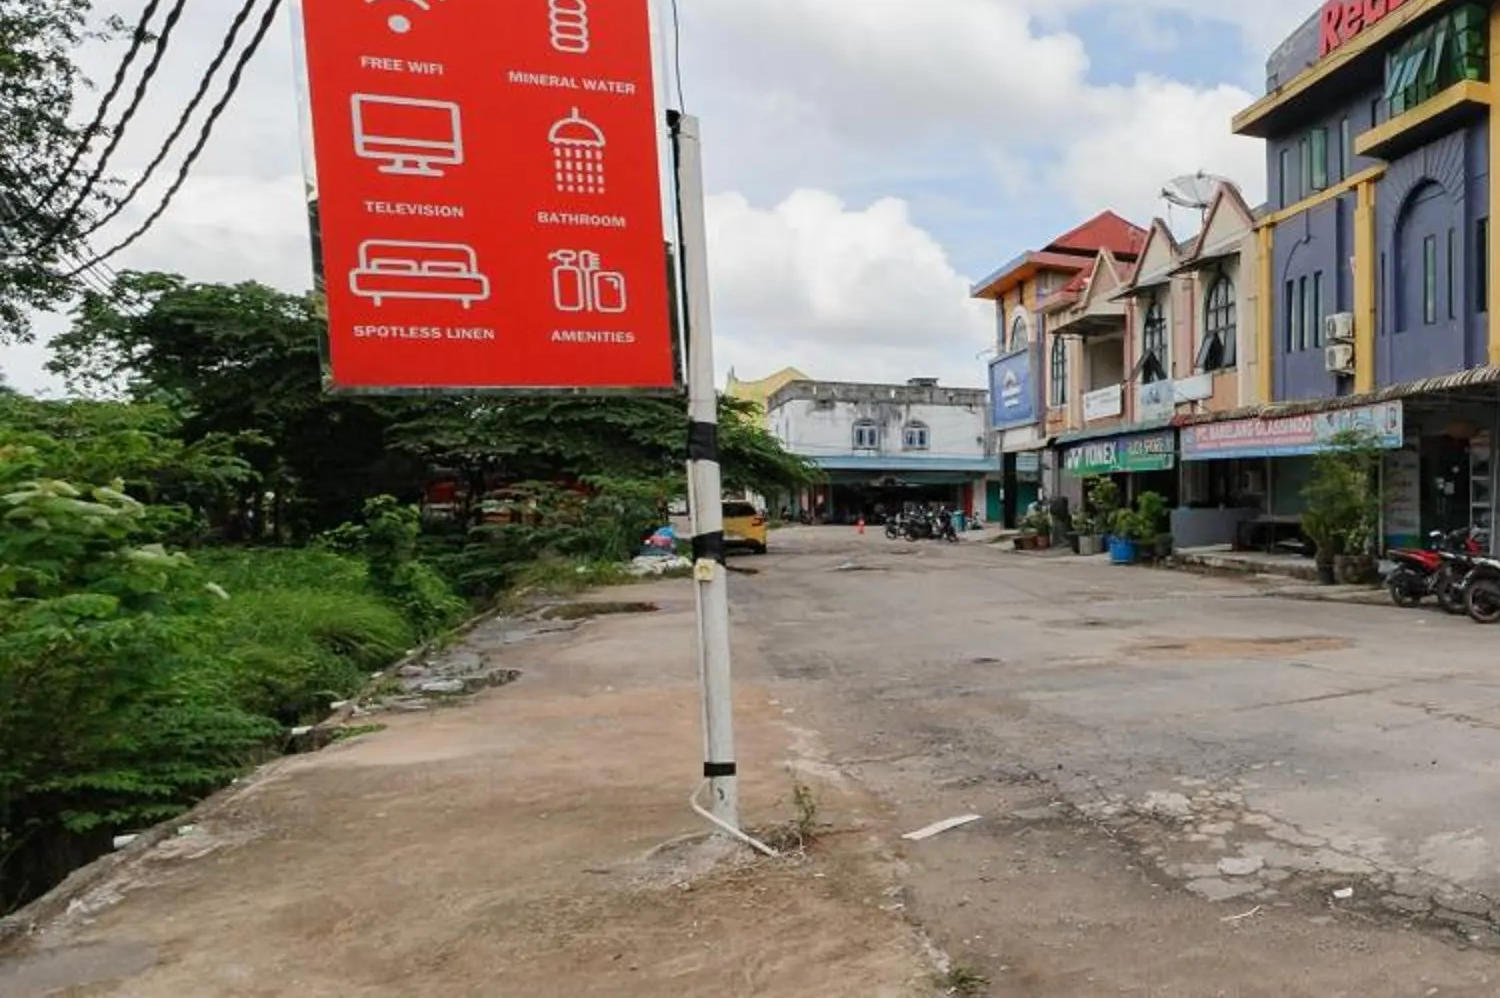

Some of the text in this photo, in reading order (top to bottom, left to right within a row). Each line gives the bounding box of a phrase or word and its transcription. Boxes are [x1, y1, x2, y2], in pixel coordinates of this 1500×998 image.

[359, 55, 444, 76] FREE WIFI
[508, 70, 637, 96] MINERAL WATER
[364, 200, 465, 219] TELEVISION
[536, 210, 627, 228] BATHROOM
[353, 324, 495, 341] SPOTLESS LINEN
[551, 329, 636, 343] AMENITIES
